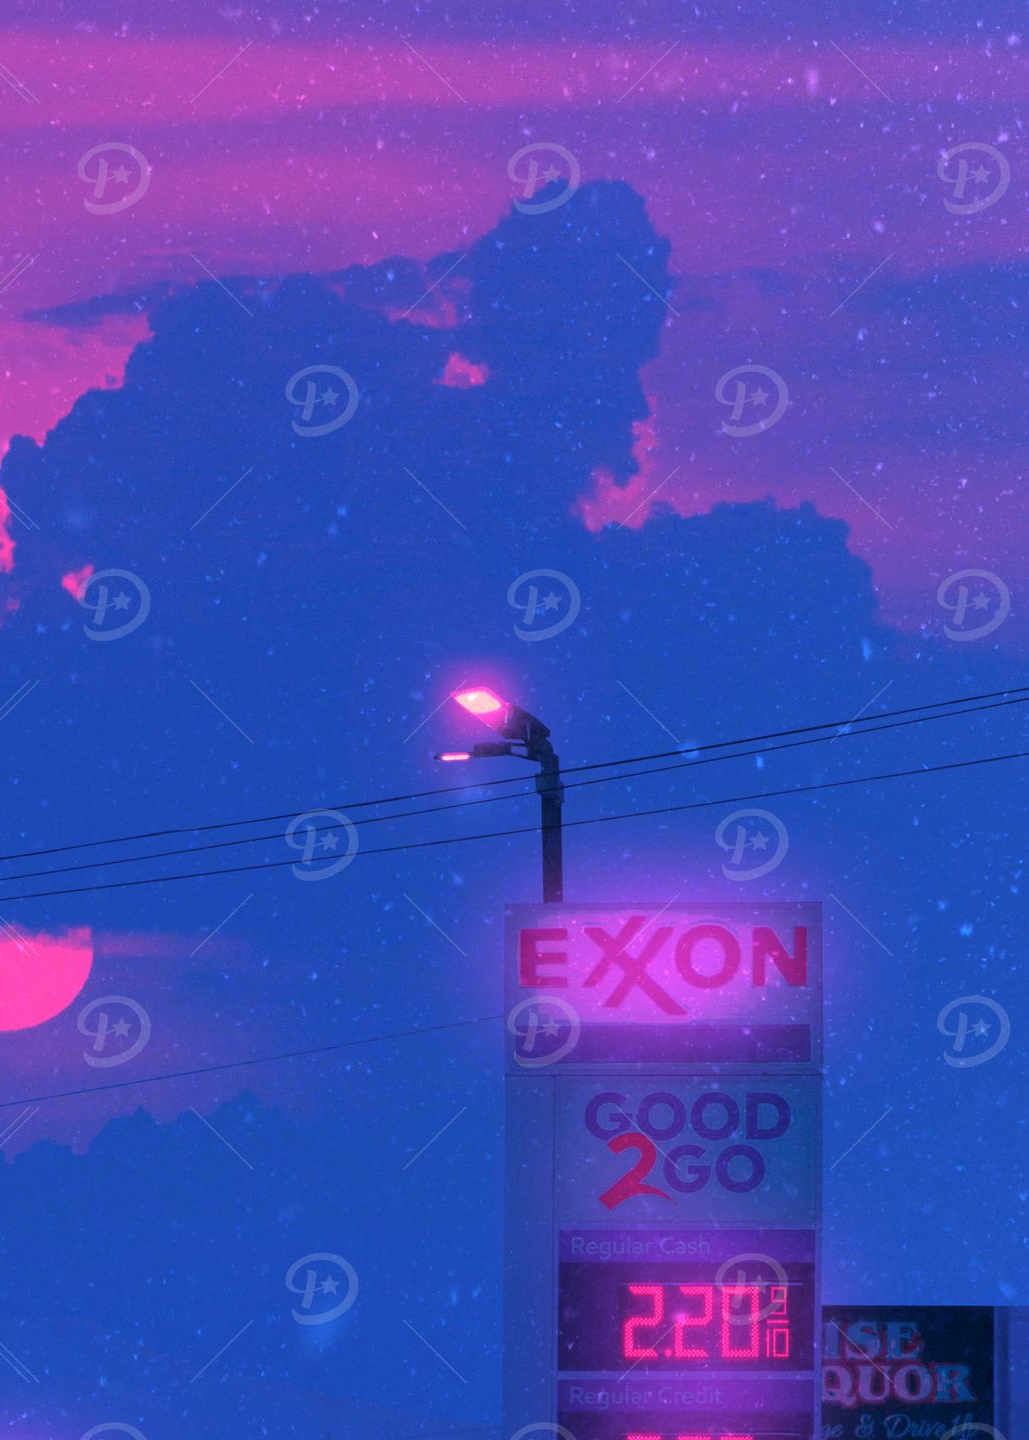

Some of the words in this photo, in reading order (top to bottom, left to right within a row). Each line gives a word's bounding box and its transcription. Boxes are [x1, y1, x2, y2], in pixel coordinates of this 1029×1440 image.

[518, 915, 808, 1016] EXXON
[584, 1091, 791, 1140] GOOD
[571, 1236, 652, 1258] Regular
[659, 1235, 711, 1255] Cash
[570, 1386, 653, 1407] Regular
[659, 1385, 723, 1406] Credit
